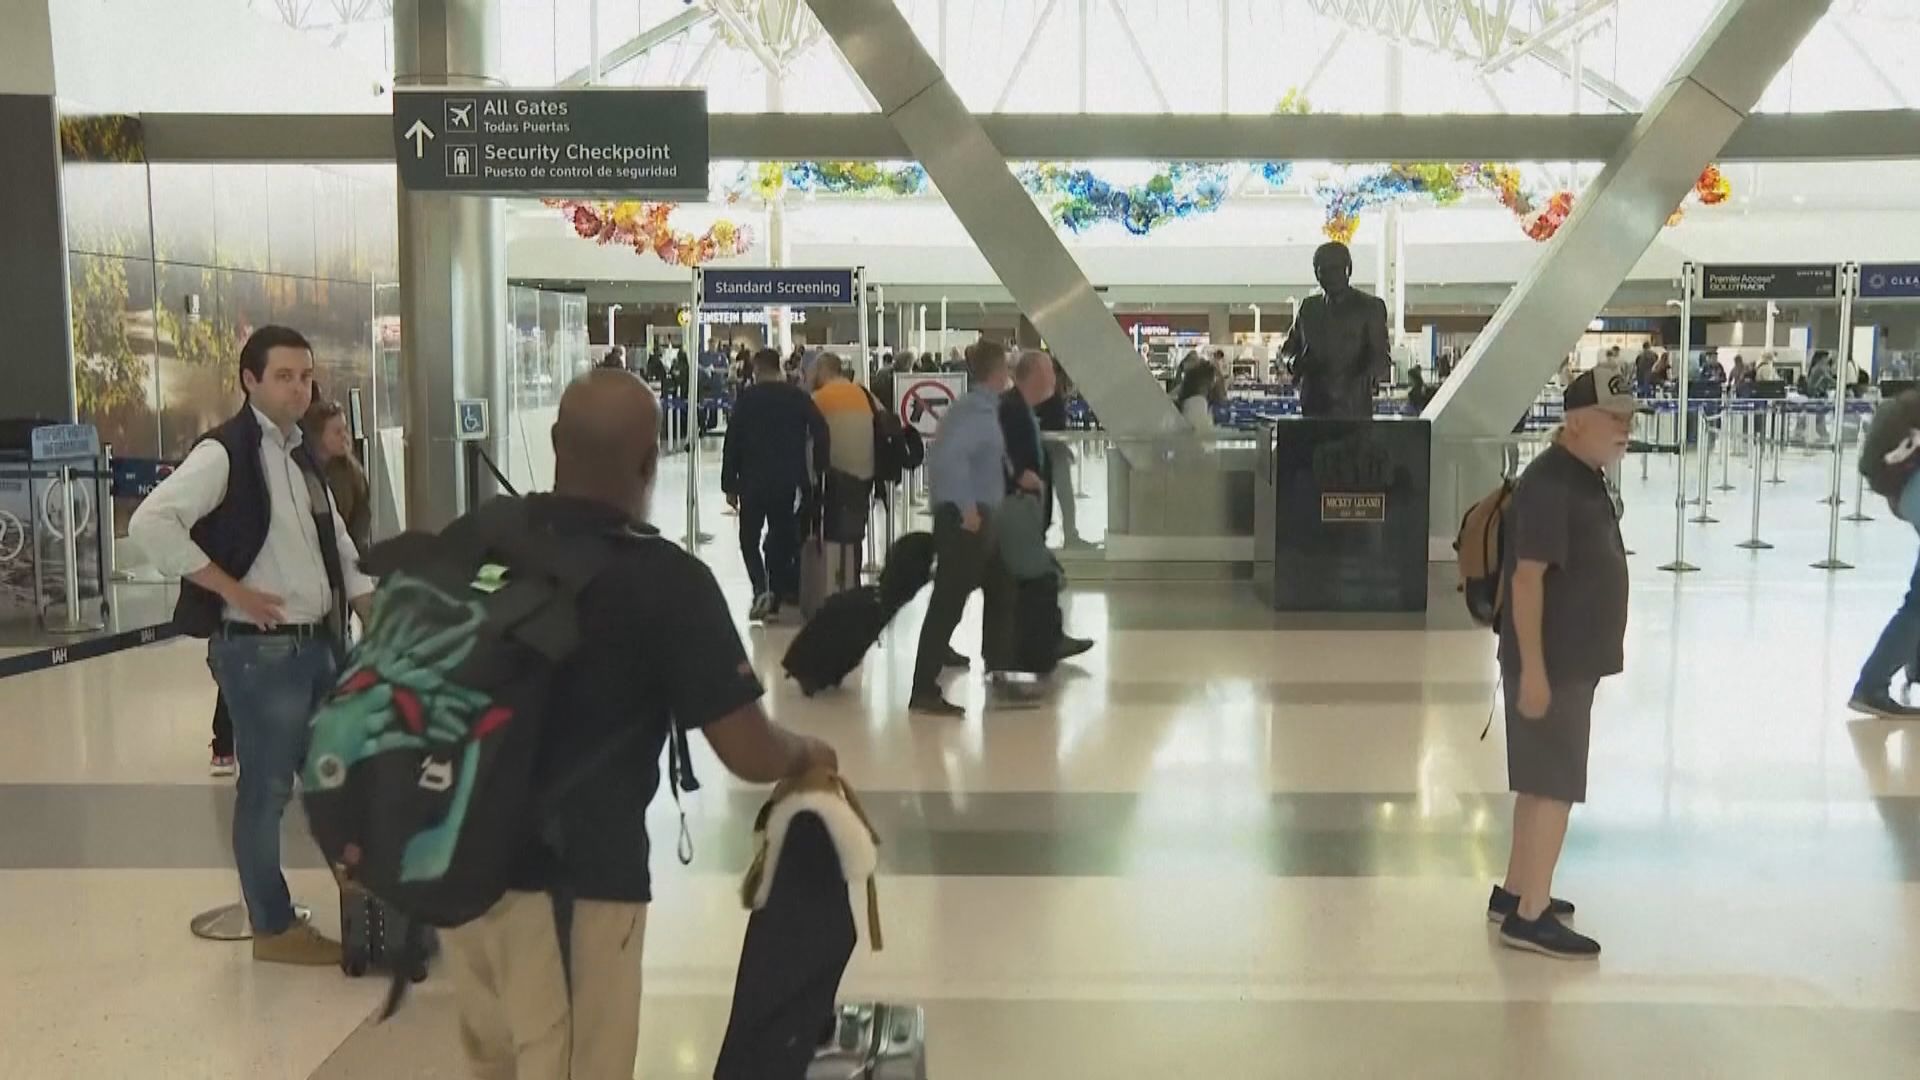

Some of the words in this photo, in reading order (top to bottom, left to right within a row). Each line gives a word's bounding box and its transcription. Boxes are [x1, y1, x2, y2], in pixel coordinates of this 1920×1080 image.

[484, 100, 508, 116] All
[515, 100, 568, 116] Gates
[484, 122, 519, 133] Todas
[523, 122, 570, 133] Puertas
[485, 144, 560, 163] Security
[566, 144, 671, 163] Checkpoint
[484, 166, 527, 178] Puesto
[531, 166, 546, 178] de
[549, 165, 593, 178] control
[597, 165, 613, 178] de
[616, 165, 677, 180] seguridad
[1709, 274, 1740, 283] Premier
[715, 281, 772, 294] Standard
[777, 281, 841, 296] Screening
[698, 312, 739, 323] EINSTEIN
[1129, 326, 1169, 335] HUSTON
[1327, 498, 1351, 507] MICKEY
